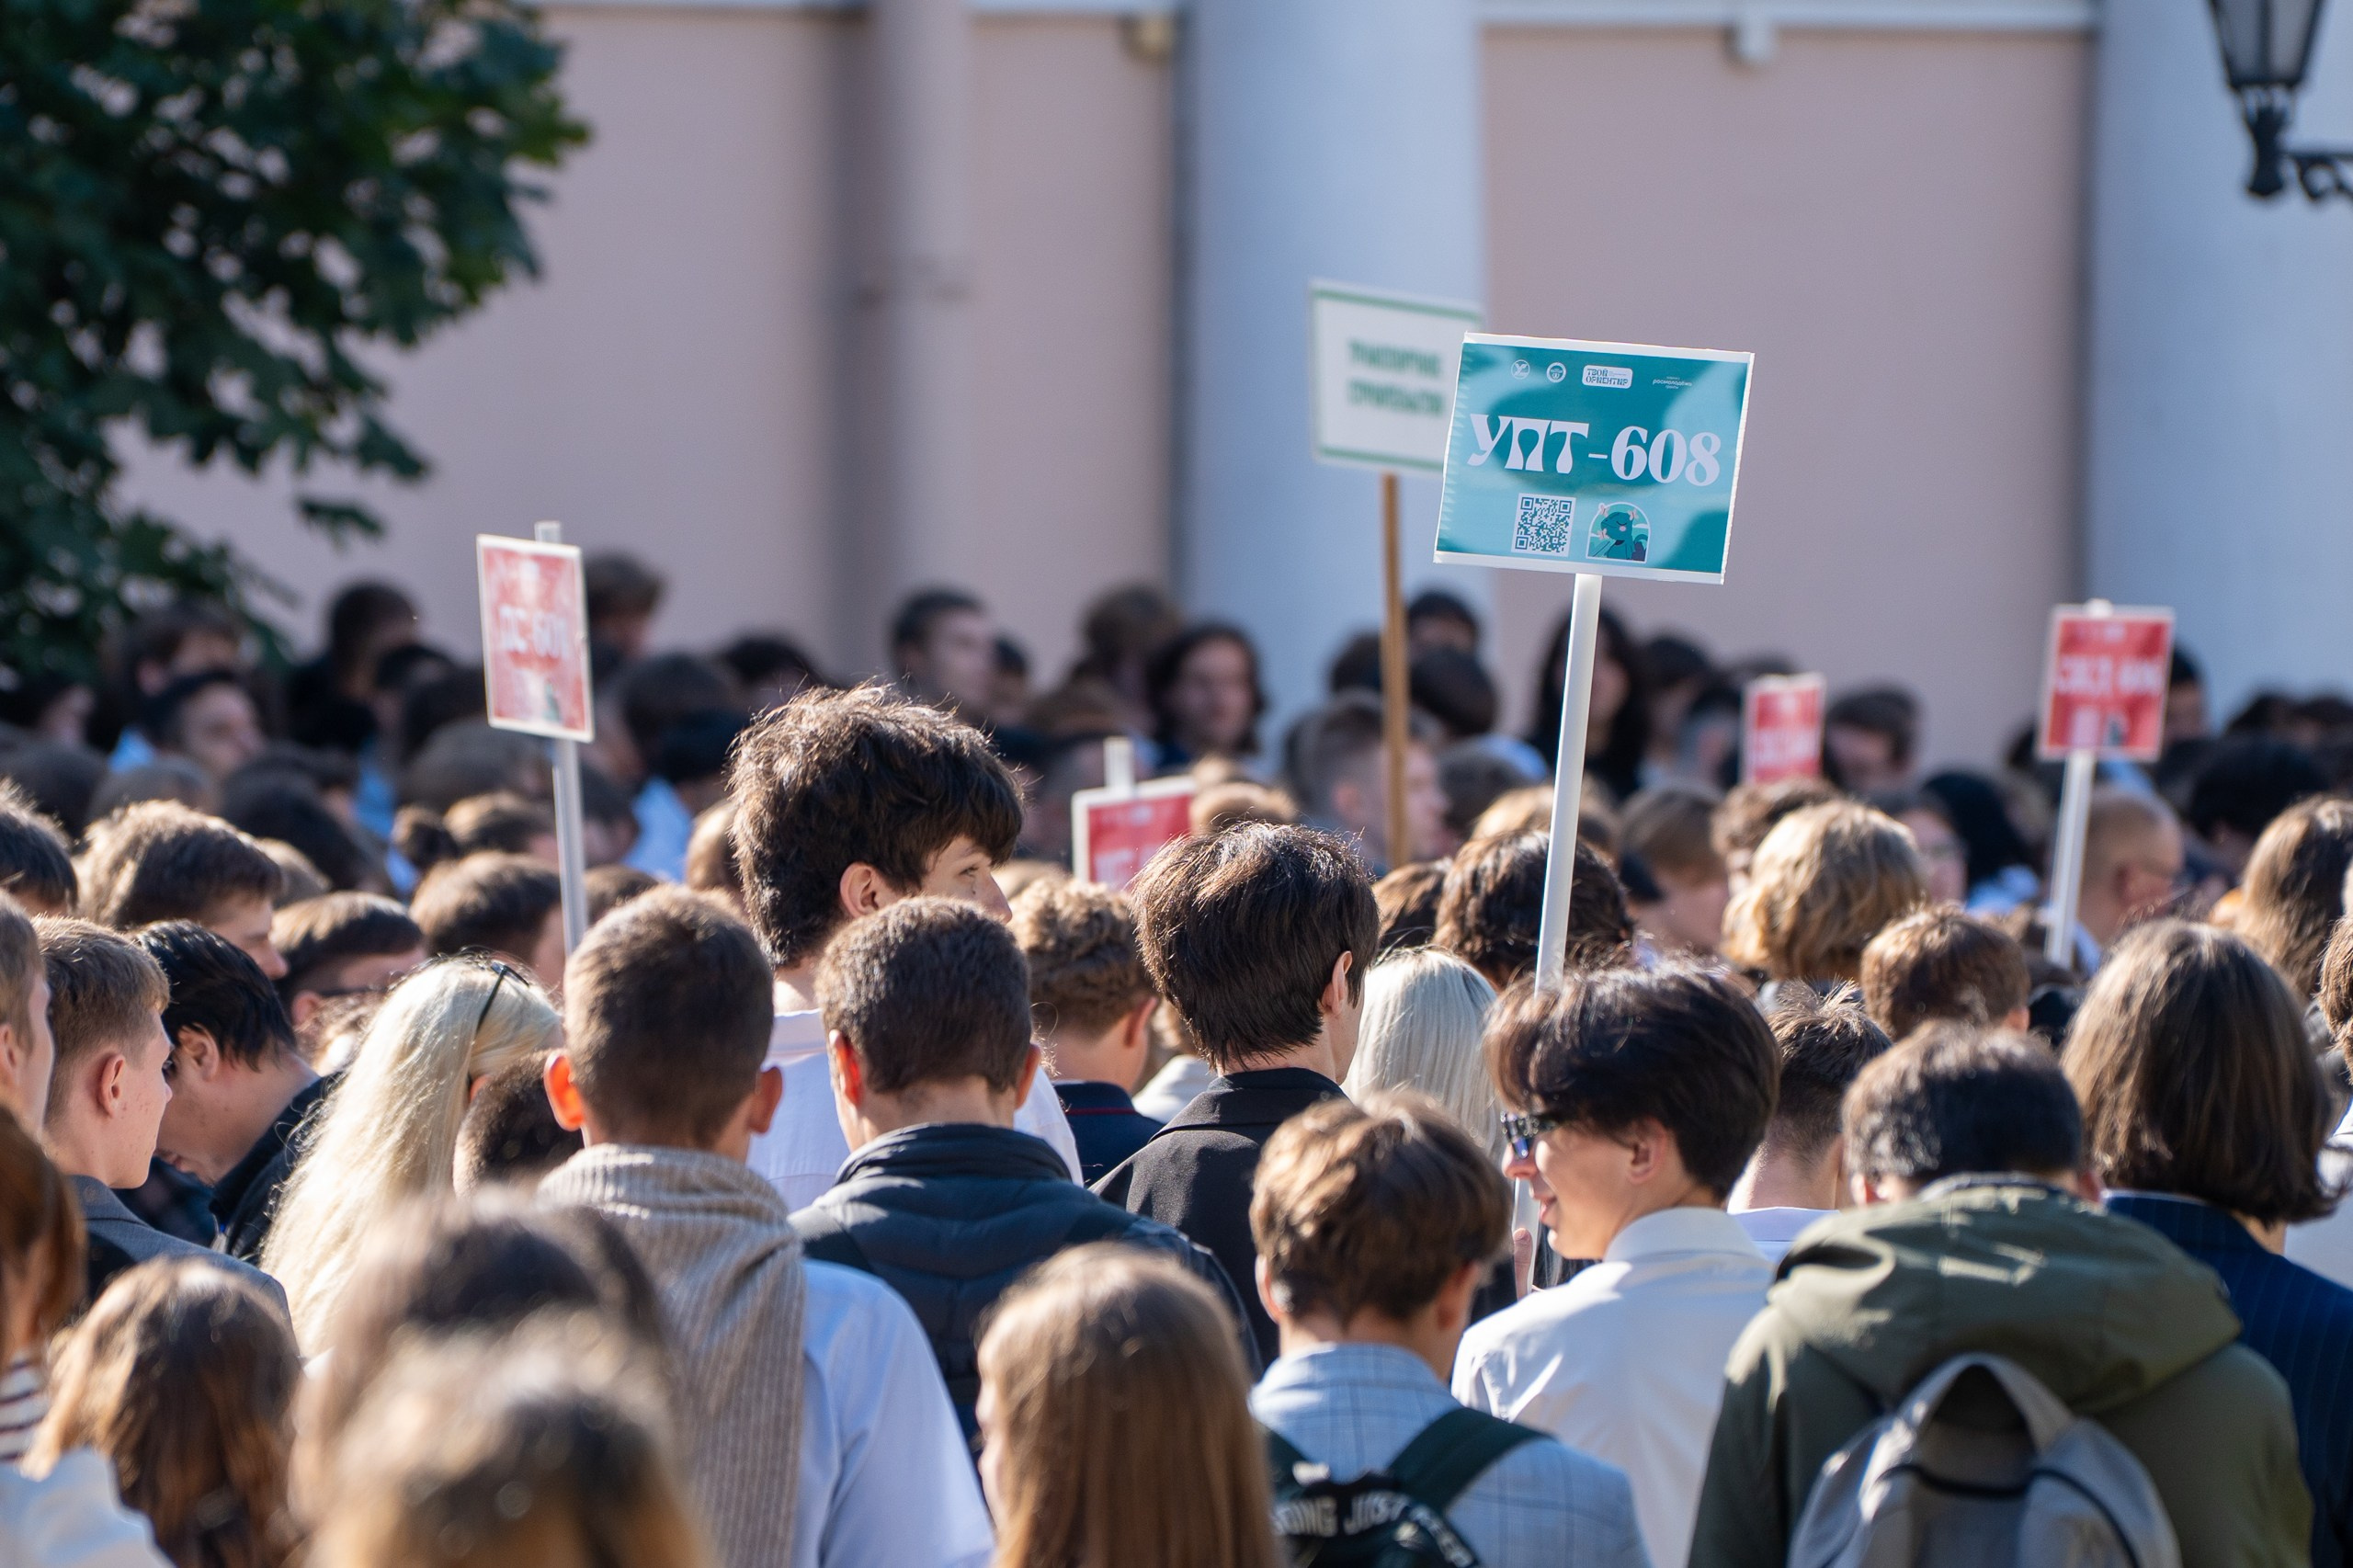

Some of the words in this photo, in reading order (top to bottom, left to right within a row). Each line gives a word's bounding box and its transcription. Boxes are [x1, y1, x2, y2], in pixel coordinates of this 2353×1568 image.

[1586, 368, 1608, 377] ТВОЙ
[1586, 375, 1629, 386] ОРИЕНТИР
[1466, 413, 1722, 486] УПТ-608
